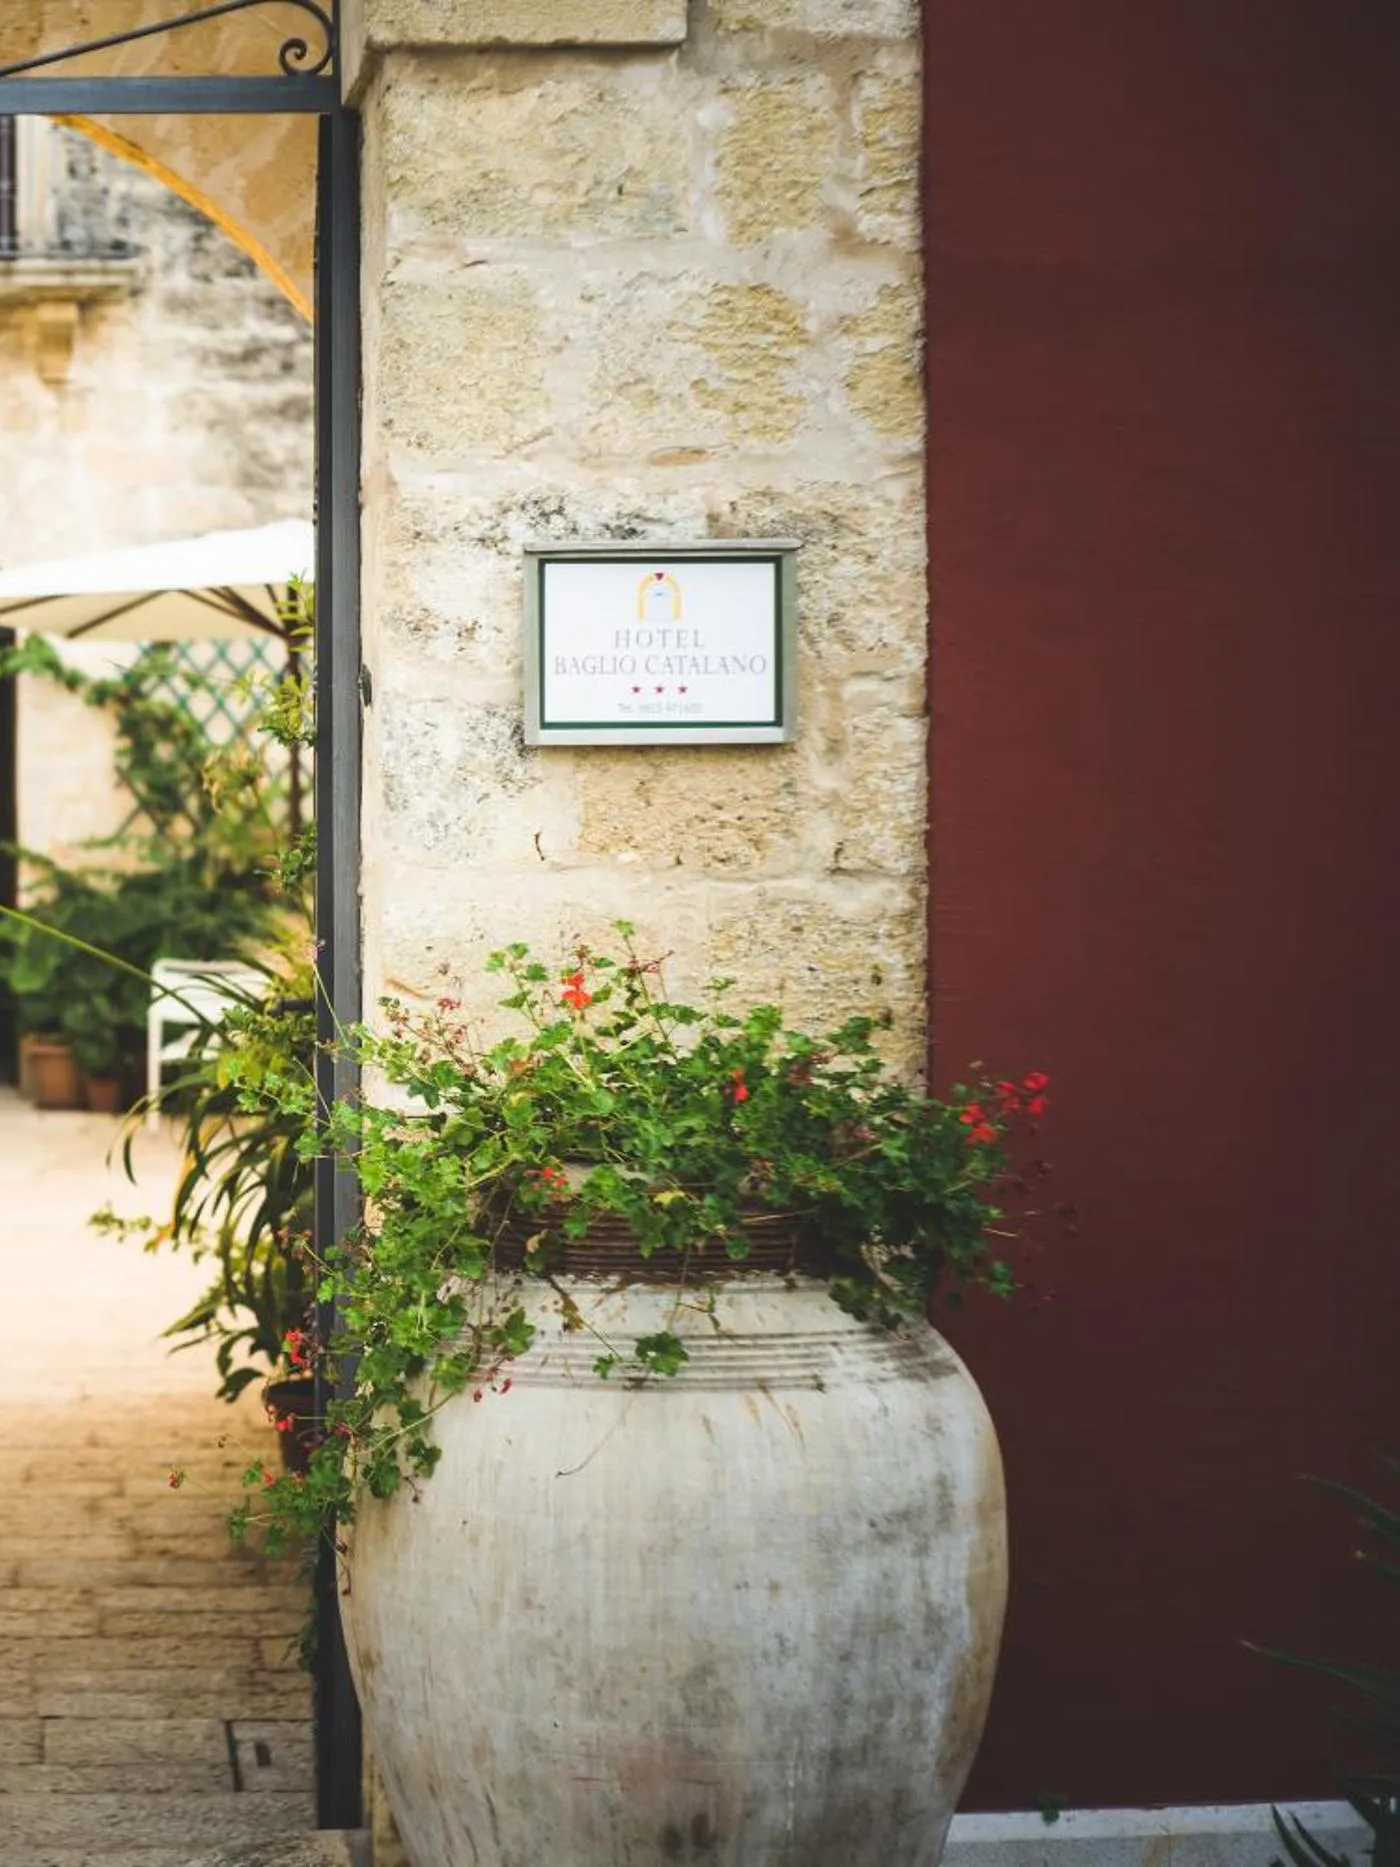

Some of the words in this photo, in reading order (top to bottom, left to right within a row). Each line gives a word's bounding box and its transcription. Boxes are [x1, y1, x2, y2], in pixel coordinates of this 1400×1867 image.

[614, 628, 705, 649] HOTEL
[554, 655, 636, 675] BAGLIO
[645, 655, 767, 675] CATALANO
